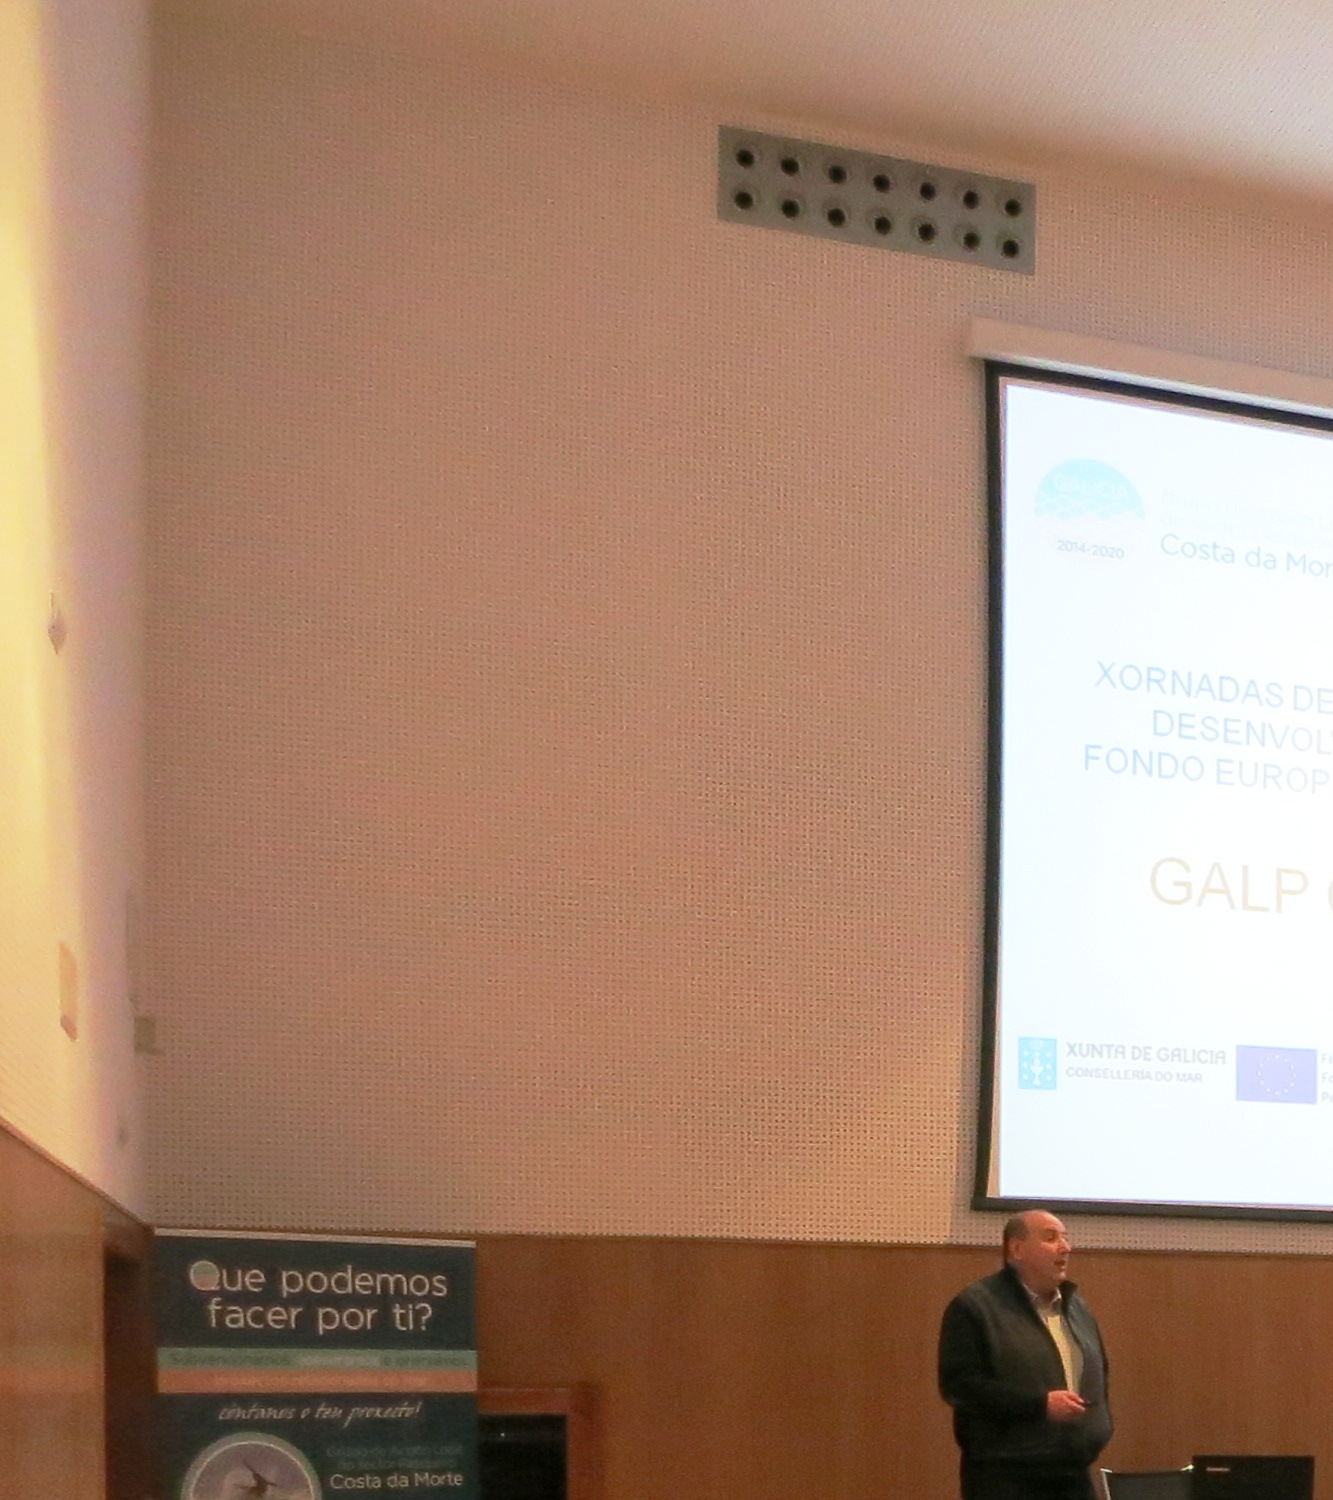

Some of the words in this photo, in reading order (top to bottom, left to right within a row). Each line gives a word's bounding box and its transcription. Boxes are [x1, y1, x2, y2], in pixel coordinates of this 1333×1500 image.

[1160, 532, 1235, 564] Costa
[1244, 546, 1277, 570] da
[1094, 660, 1284, 709] XORNADAS
[1083, 743, 1205, 782] FONDO
[1149, 856, 1309, 914] GALP
[1065, 1042, 1126, 1060] XUNTA
[1130, 1045, 1153, 1061] DE
[1156, 1047, 1227, 1065] GALICIA
[189, 1260, 266, 1292] Que
[281, 1265, 448, 1298] podemos
[207, 1297, 303, 1330] facer
[317, 1306, 379, 1336] por
[392, 1302, 433, 1331] ti?
[300, 1408, 309, 1420] o
[314, 1402, 343, 1420] teu
[329, 1473, 382, 1490] Costa
[386, 1472, 409, 1488] da
[413, 1471, 464, 1487] Morte
